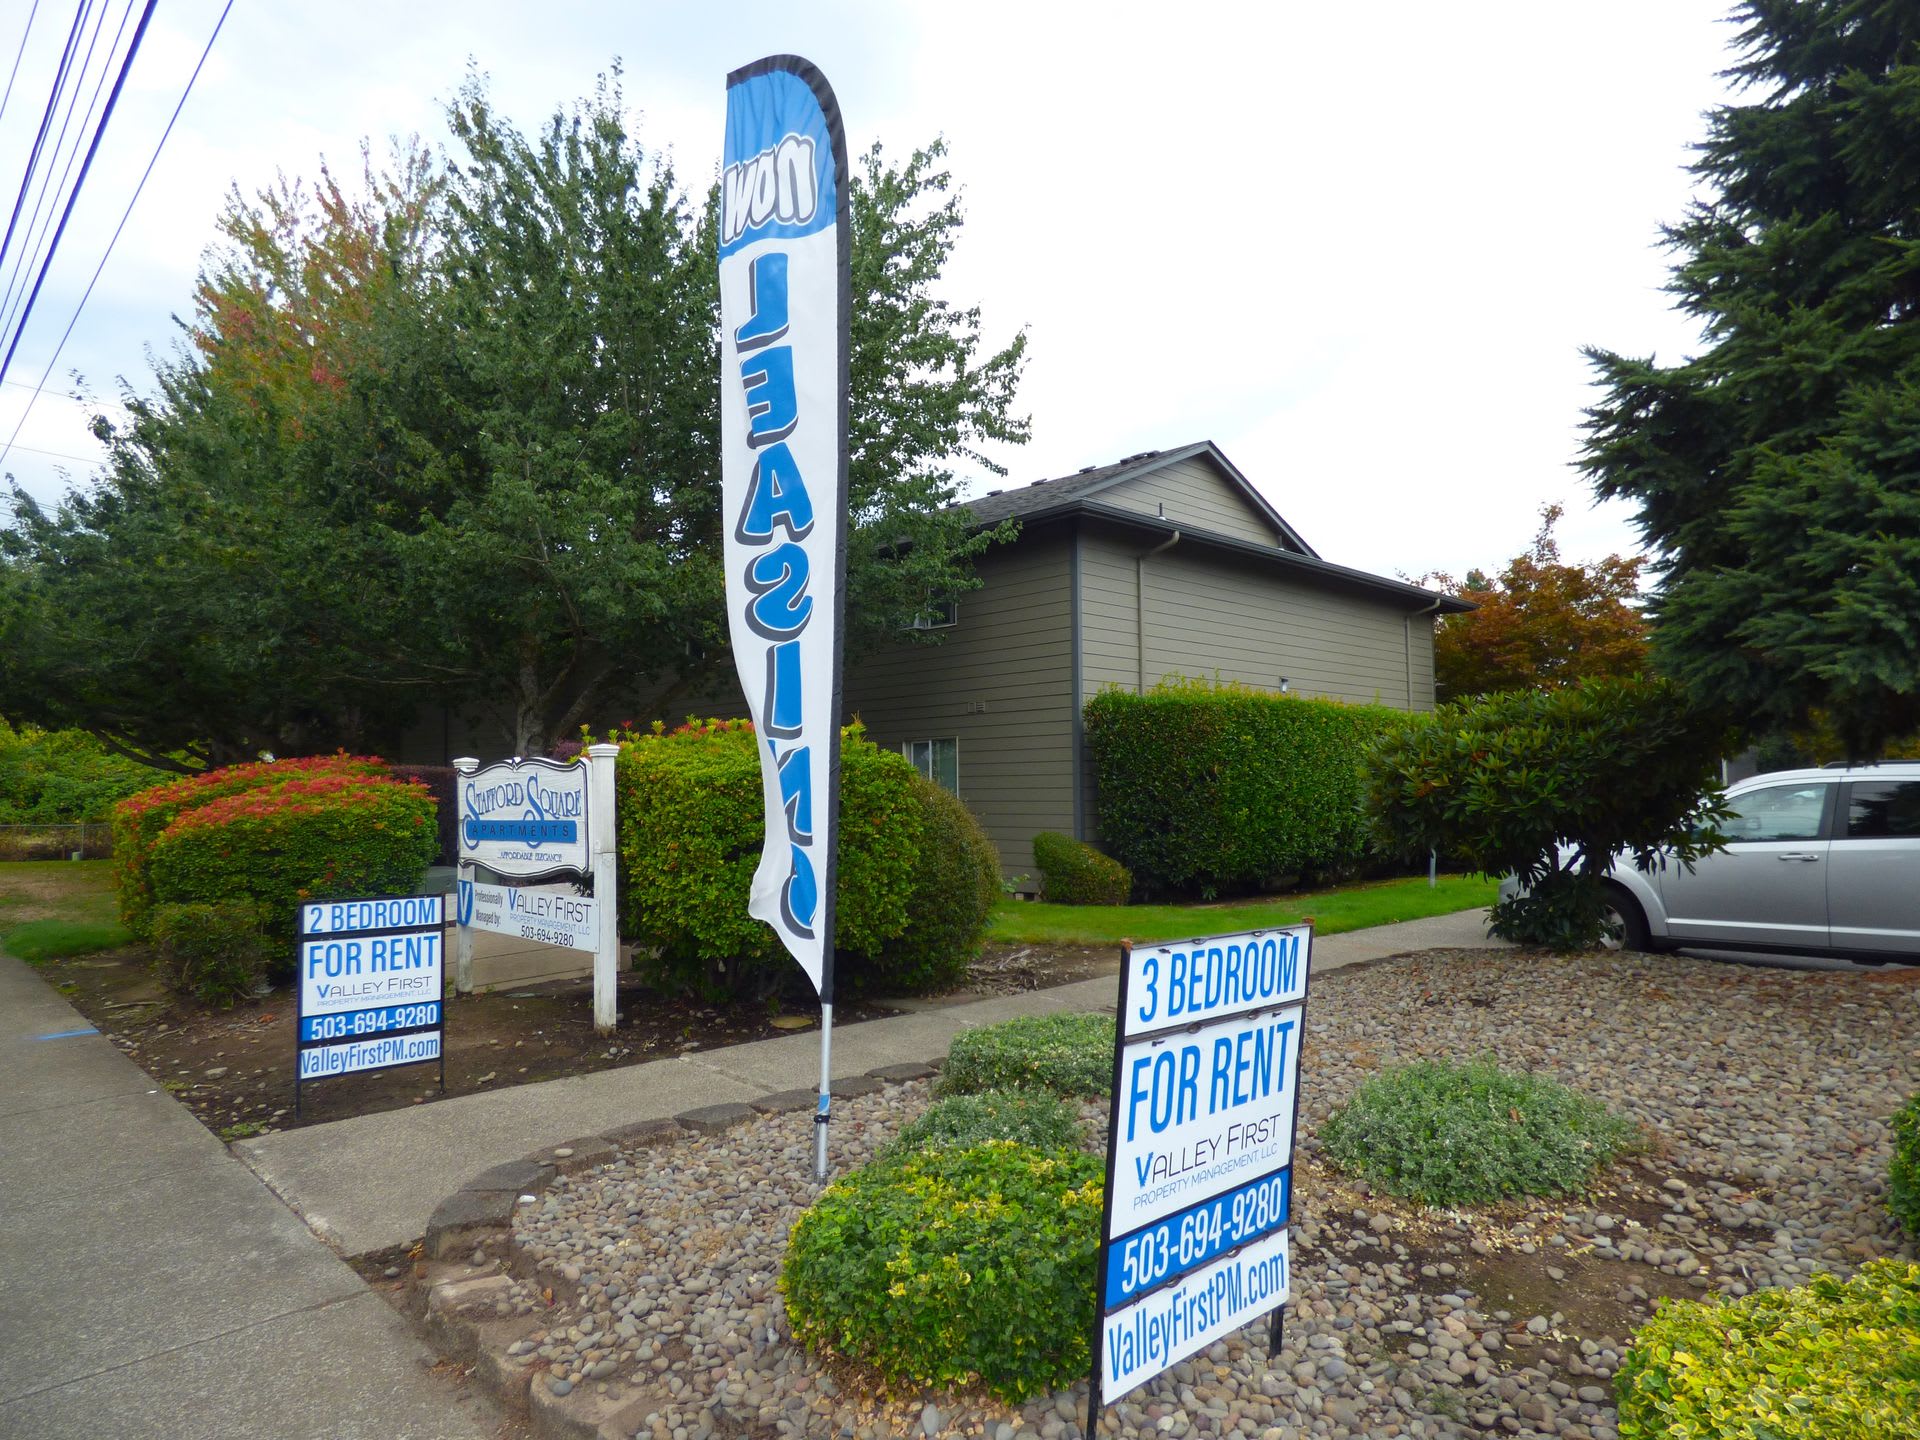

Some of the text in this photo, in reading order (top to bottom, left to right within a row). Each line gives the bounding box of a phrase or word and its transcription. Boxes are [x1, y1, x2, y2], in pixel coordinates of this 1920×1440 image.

[462, 772, 582, 850] STAFFORD SQUARE
[471, 823, 570, 837] APARTMENTS
[309, 898, 436, 933] 2 BEDROOM
[475, 889, 503, 908] Professionally
[508, 888, 592, 924] VALLEY FIRST
[475, 909, 494, 925] Managed
[509, 913, 538, 926] PROPERTY
[578, 926, 591, 936] LLC
[521, 925, 574, 947] 503-694-9280
[309, 935, 438, 979] FOR RENT
[316, 976, 433, 999] VALLEY FIRST
[1139, 936, 1300, 1023] 3 BEDROOM
[311, 1004, 438, 1040] 503-694-9280
[301, 1038, 438, 1073] ValleyFirstPM.com
[1127, 1020, 1295, 1143] FOR RENT
[1135, 1114, 1281, 1188] VALLEY FIRST
[1133, 1177, 1190, 1211] PROPERTY
[1261, 1142, 1279, 1159] LLC
[1121, 1177, 1283, 1294] 503-694-9280
[1109, 1252, 1285, 1383] ValleyFirstPM.com
